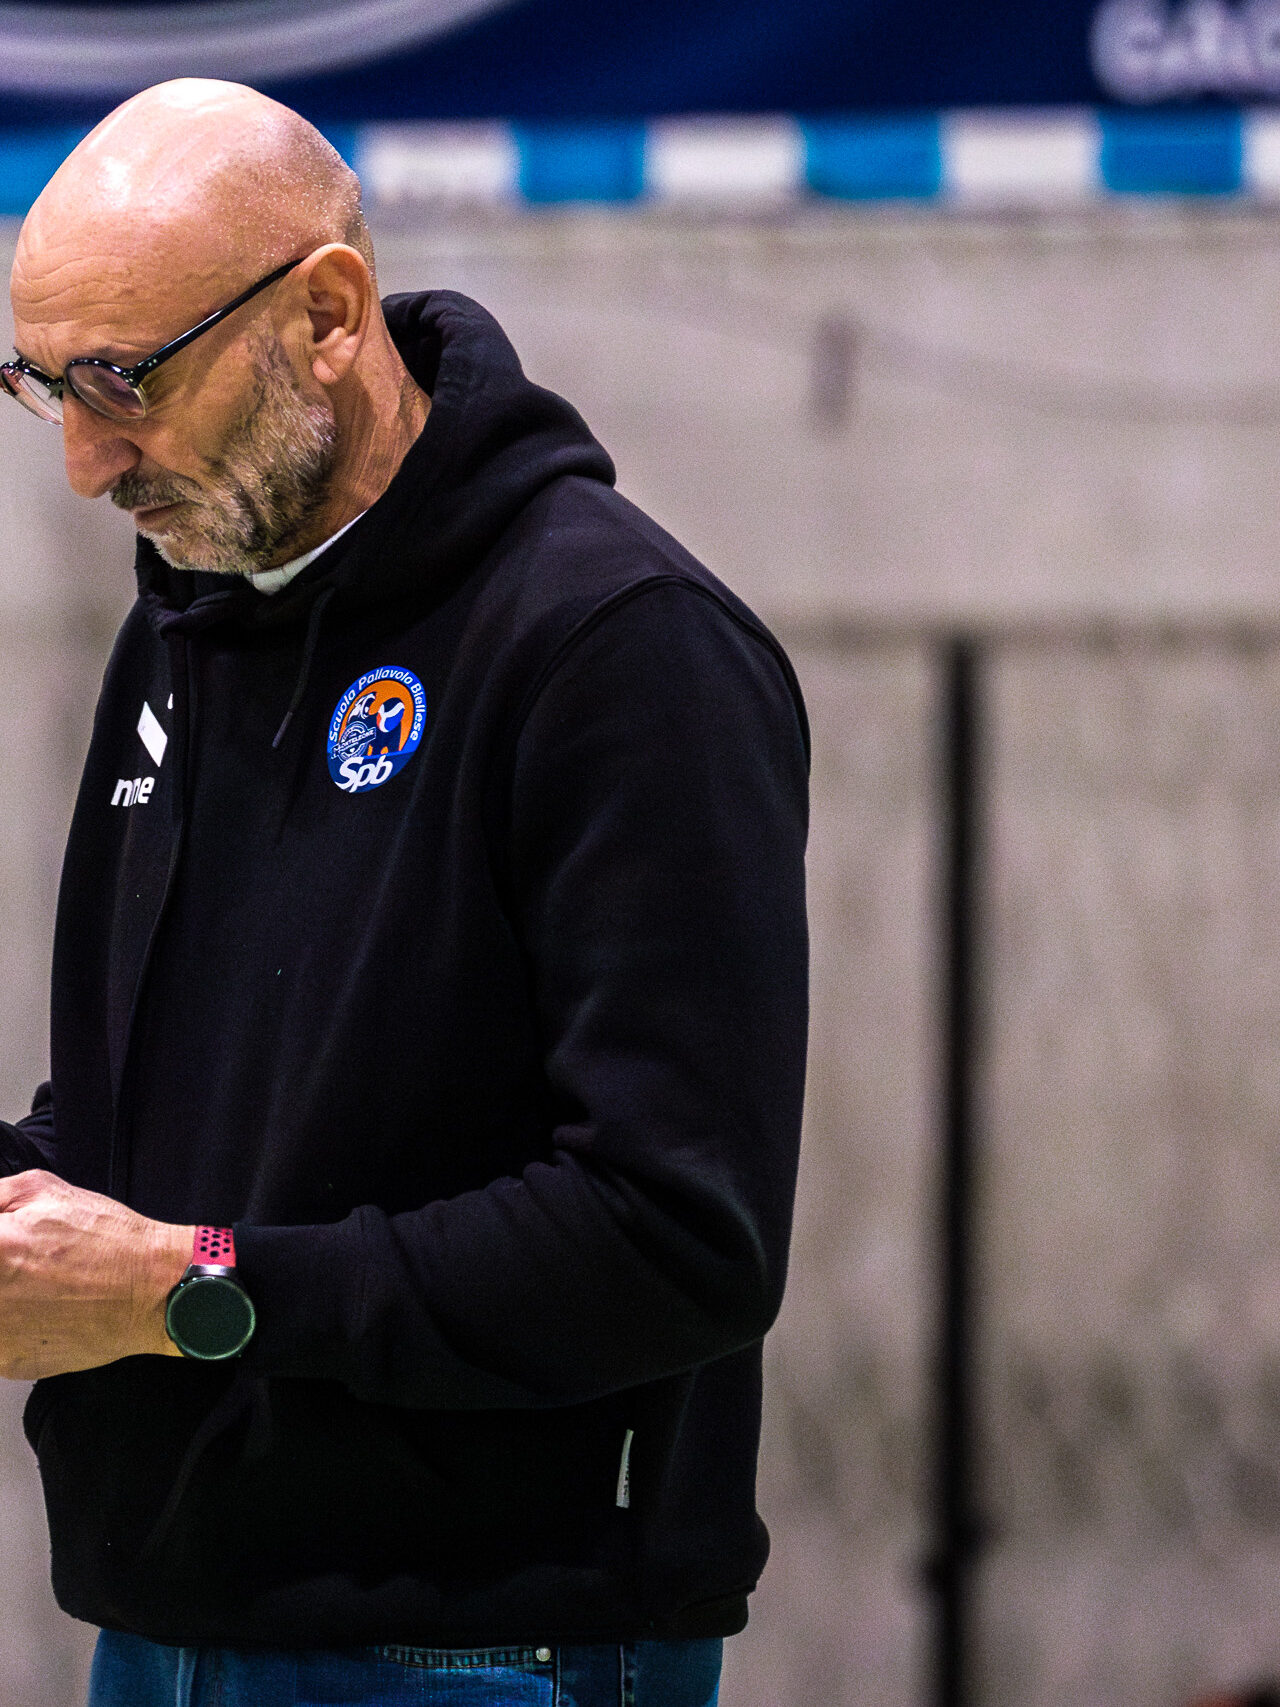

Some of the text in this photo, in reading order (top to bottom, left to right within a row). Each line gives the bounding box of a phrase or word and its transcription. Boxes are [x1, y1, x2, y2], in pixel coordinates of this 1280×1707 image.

[329, 667, 426, 742] Scuola Pallavolo Biellese
[334, 755, 394, 793] Spb
